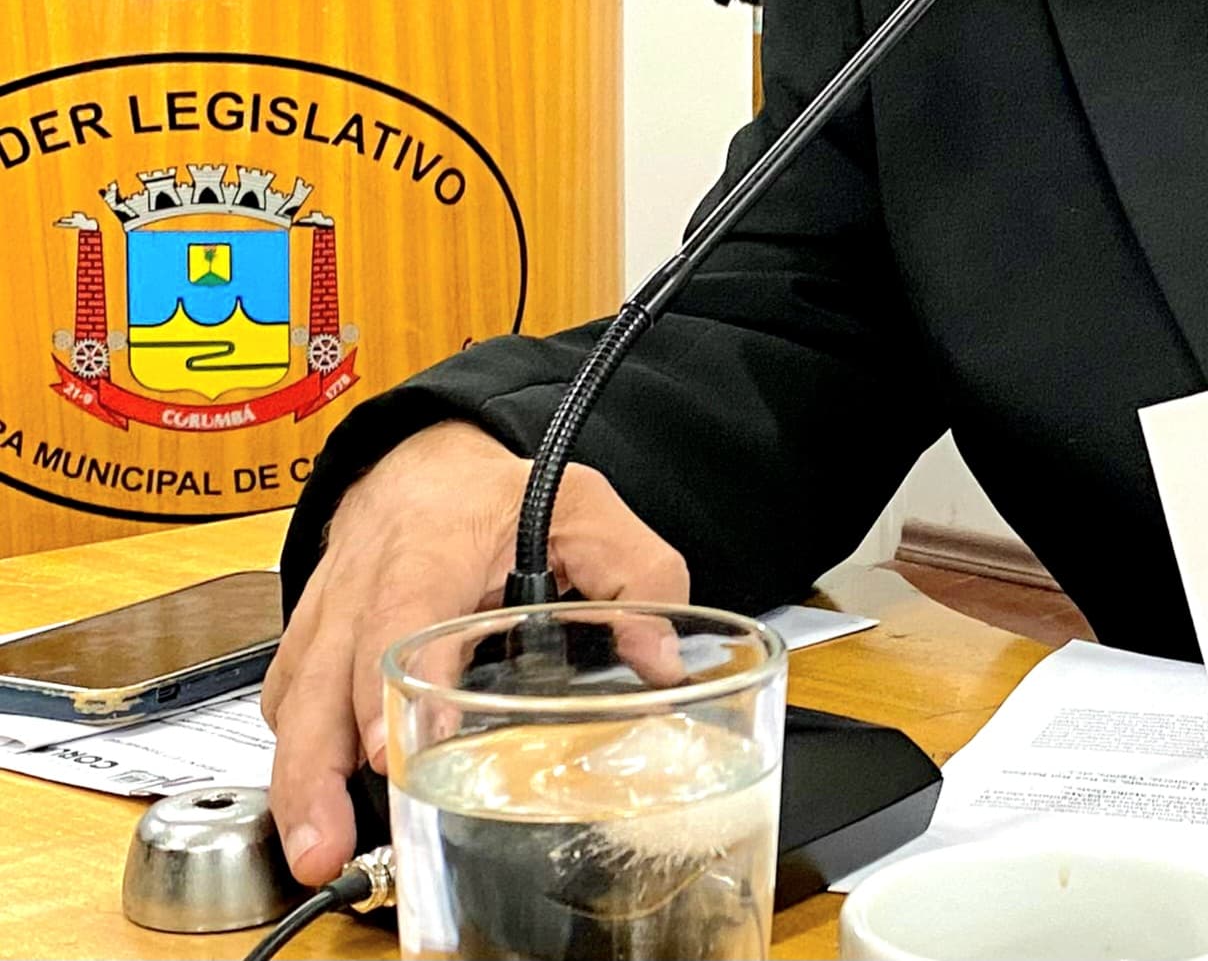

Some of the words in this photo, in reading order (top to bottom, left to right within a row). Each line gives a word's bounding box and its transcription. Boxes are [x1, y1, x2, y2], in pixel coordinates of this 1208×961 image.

[129, 91, 467, 205] LEGISLATIVO
[161, 404, 256, 430] CORUMBÁ
[33, 441, 222, 496] MUNICIPAL
[234, 464, 280, 494] DE
[290, 453, 320, 483] C
